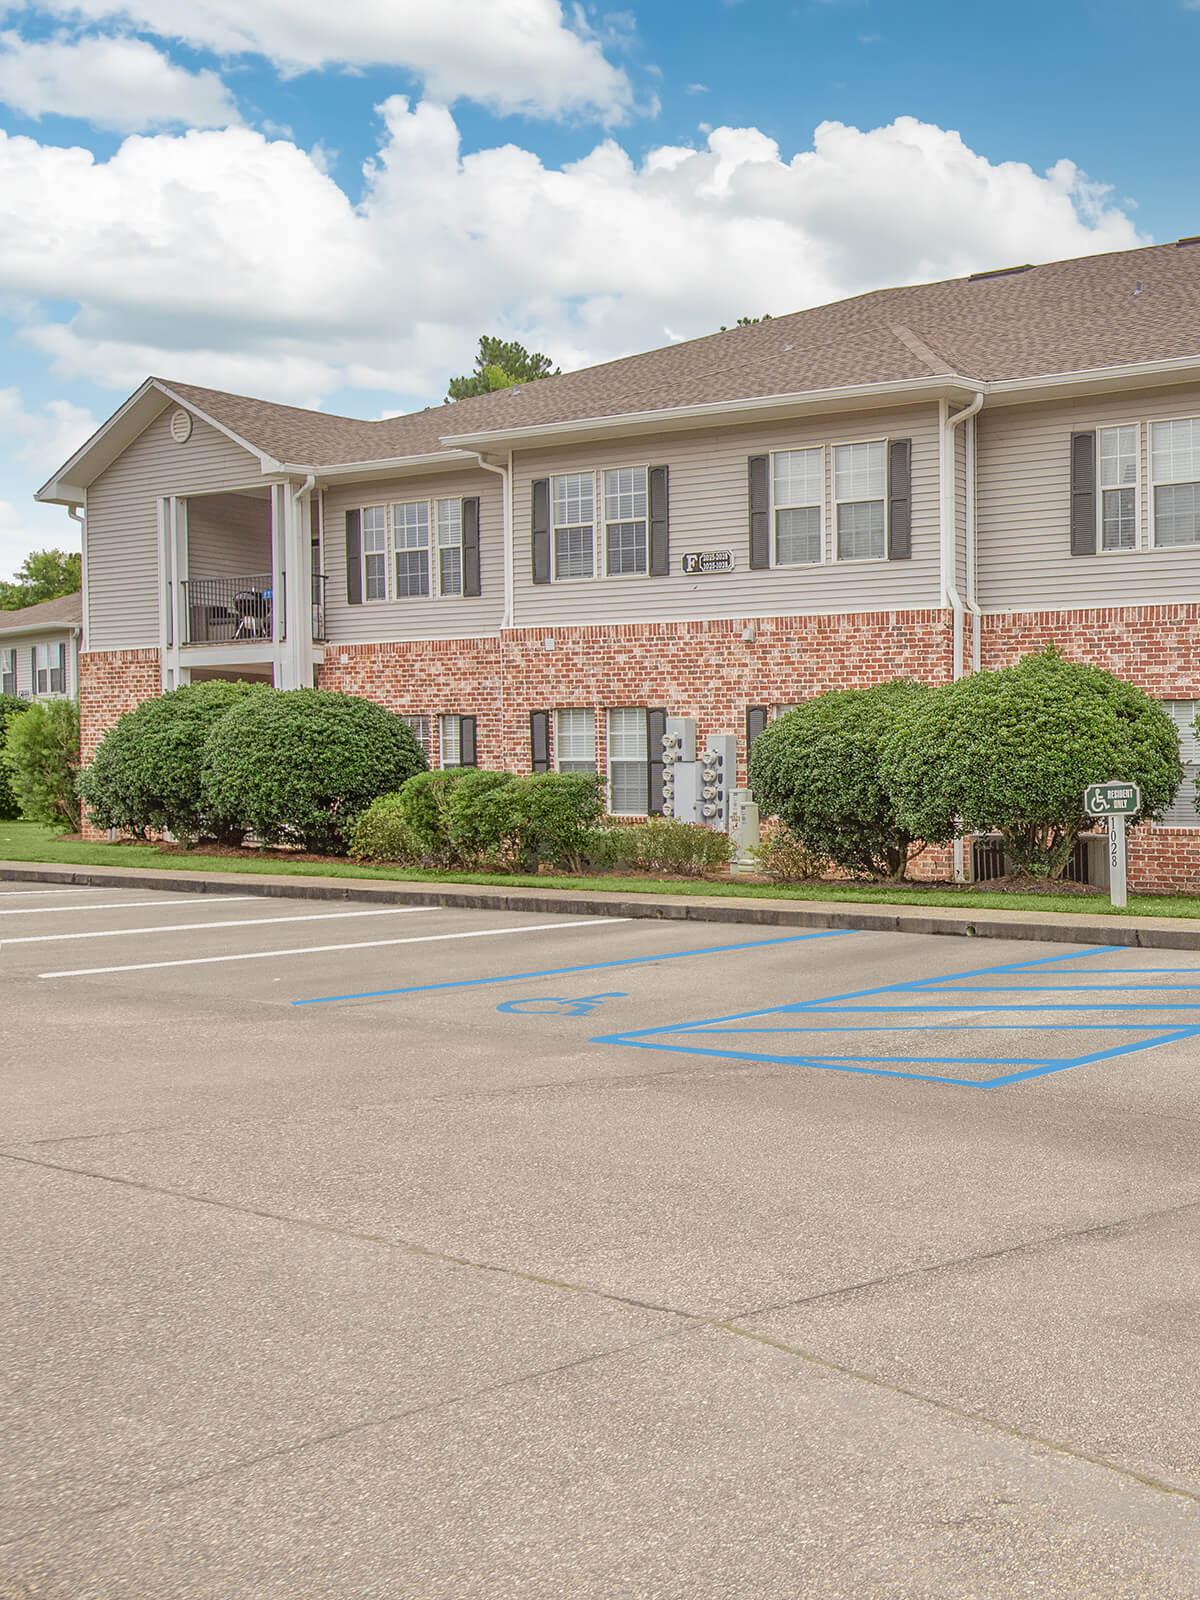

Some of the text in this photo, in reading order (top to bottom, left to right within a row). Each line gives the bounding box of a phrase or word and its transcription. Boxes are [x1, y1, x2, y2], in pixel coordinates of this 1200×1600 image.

[686, 555, 698, 571] F
[1107, 789, 1133, 799] RESIDENT
[1114, 799, 1128, 809] ONLY
